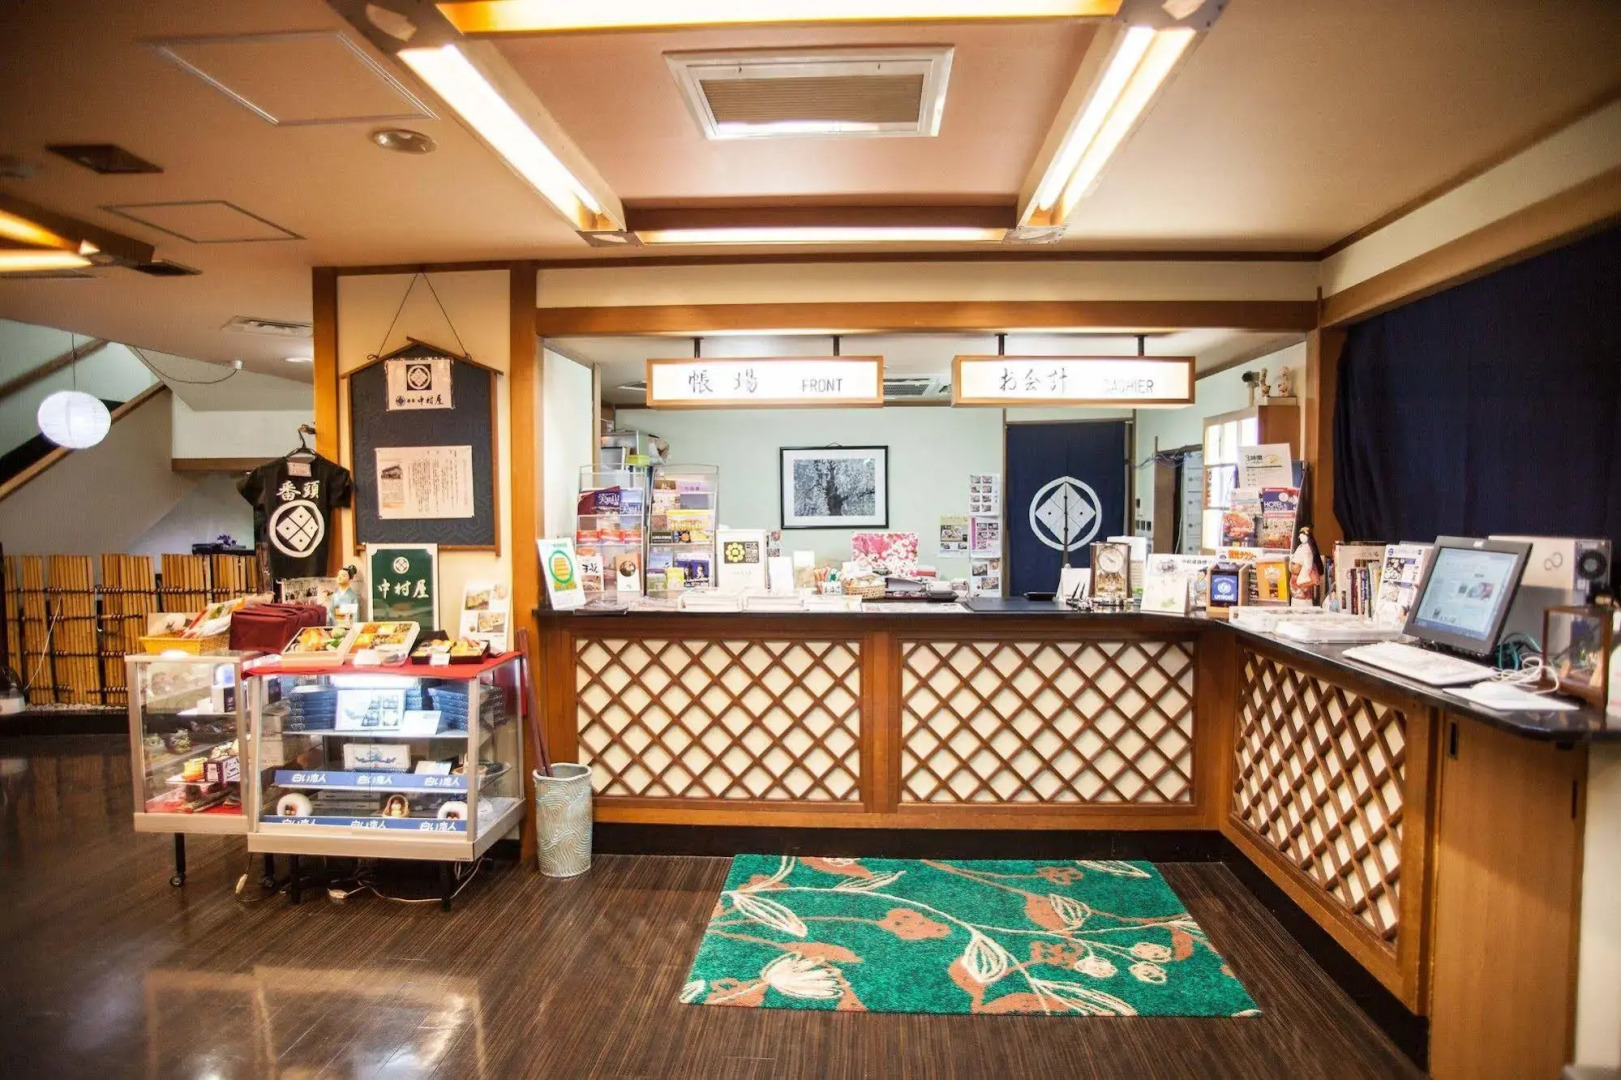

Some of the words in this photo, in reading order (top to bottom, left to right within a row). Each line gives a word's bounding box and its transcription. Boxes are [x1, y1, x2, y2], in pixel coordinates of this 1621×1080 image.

[688, 368, 758, 393] 帳場
[801, 378, 843, 393] FRONT
[999, 367, 1068, 394] お会計
[276, 480, 320, 500] 番頭
[378, 578, 430, 599] 中村屋
[291, 772, 327, 783] 白い恋人
[357, 774, 393, 785] 白い恋人
[424, 776, 460, 787] 白い恋人
